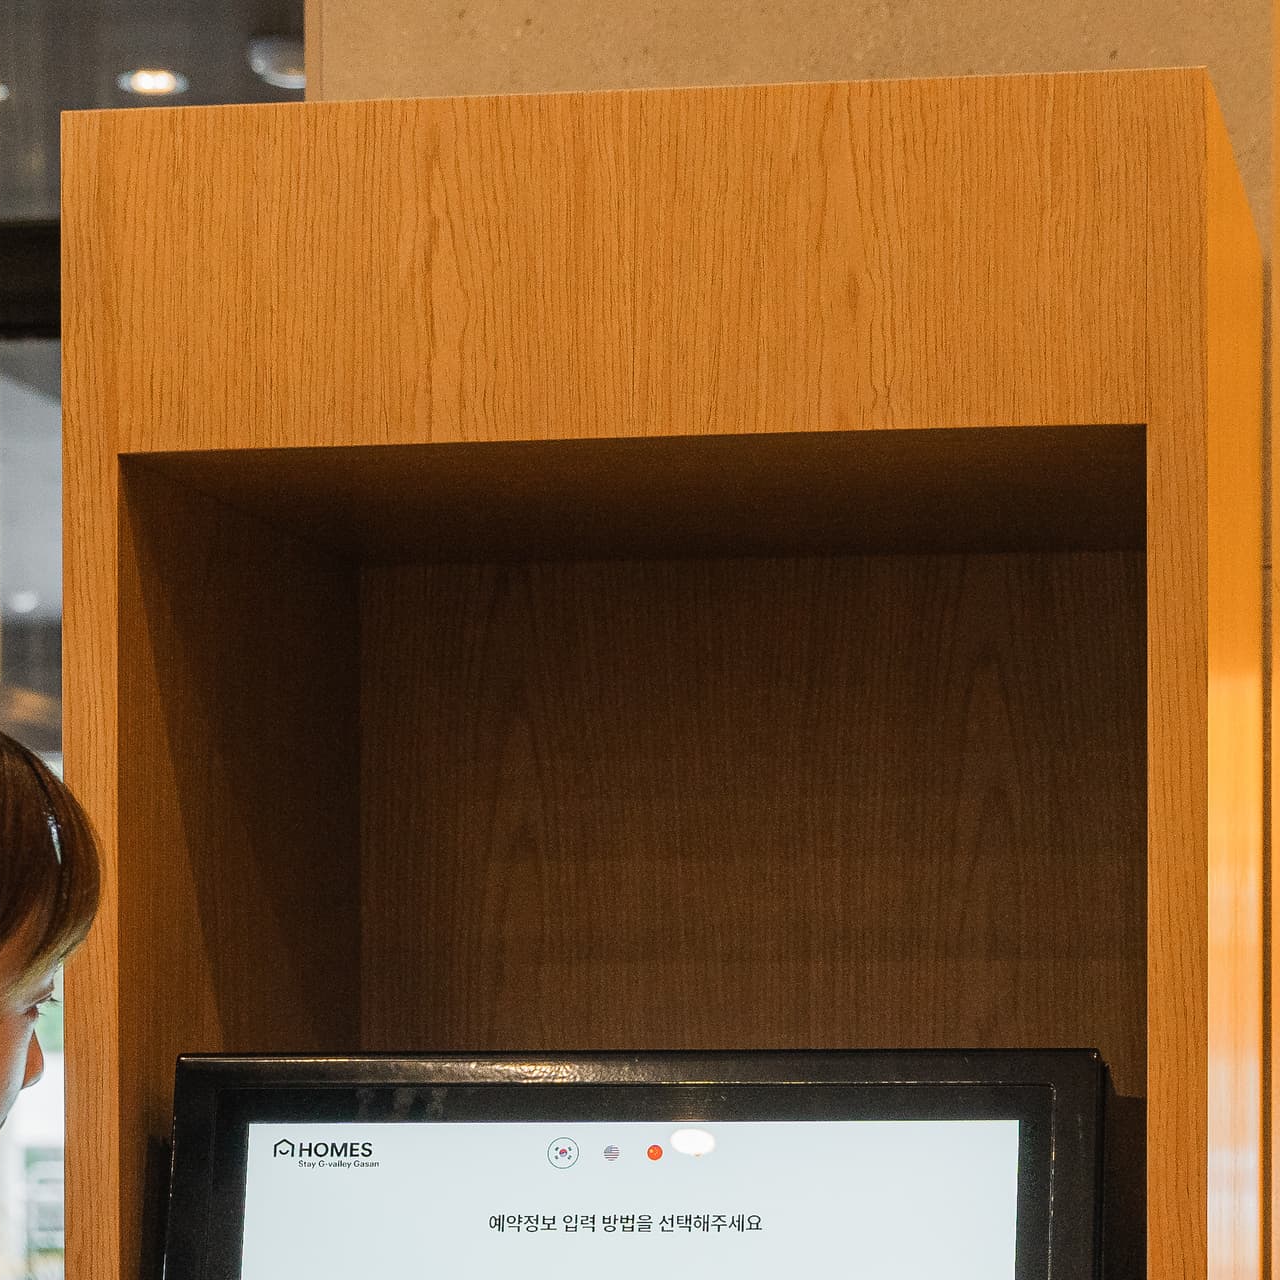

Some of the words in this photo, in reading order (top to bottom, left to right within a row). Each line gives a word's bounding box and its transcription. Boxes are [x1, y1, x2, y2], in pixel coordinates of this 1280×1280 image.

[298, 1142, 373, 1158] HOMES
[298, 1160, 316, 1168] Stay
[353, 1160, 380, 1168] Gasan
[488, 1213, 558, 1233] 예약정보
[562, 1213, 596, 1233] 입력
[602, 1213, 654, 1233] 방법을
[658, 1213, 763, 1233] 선택해주세요
